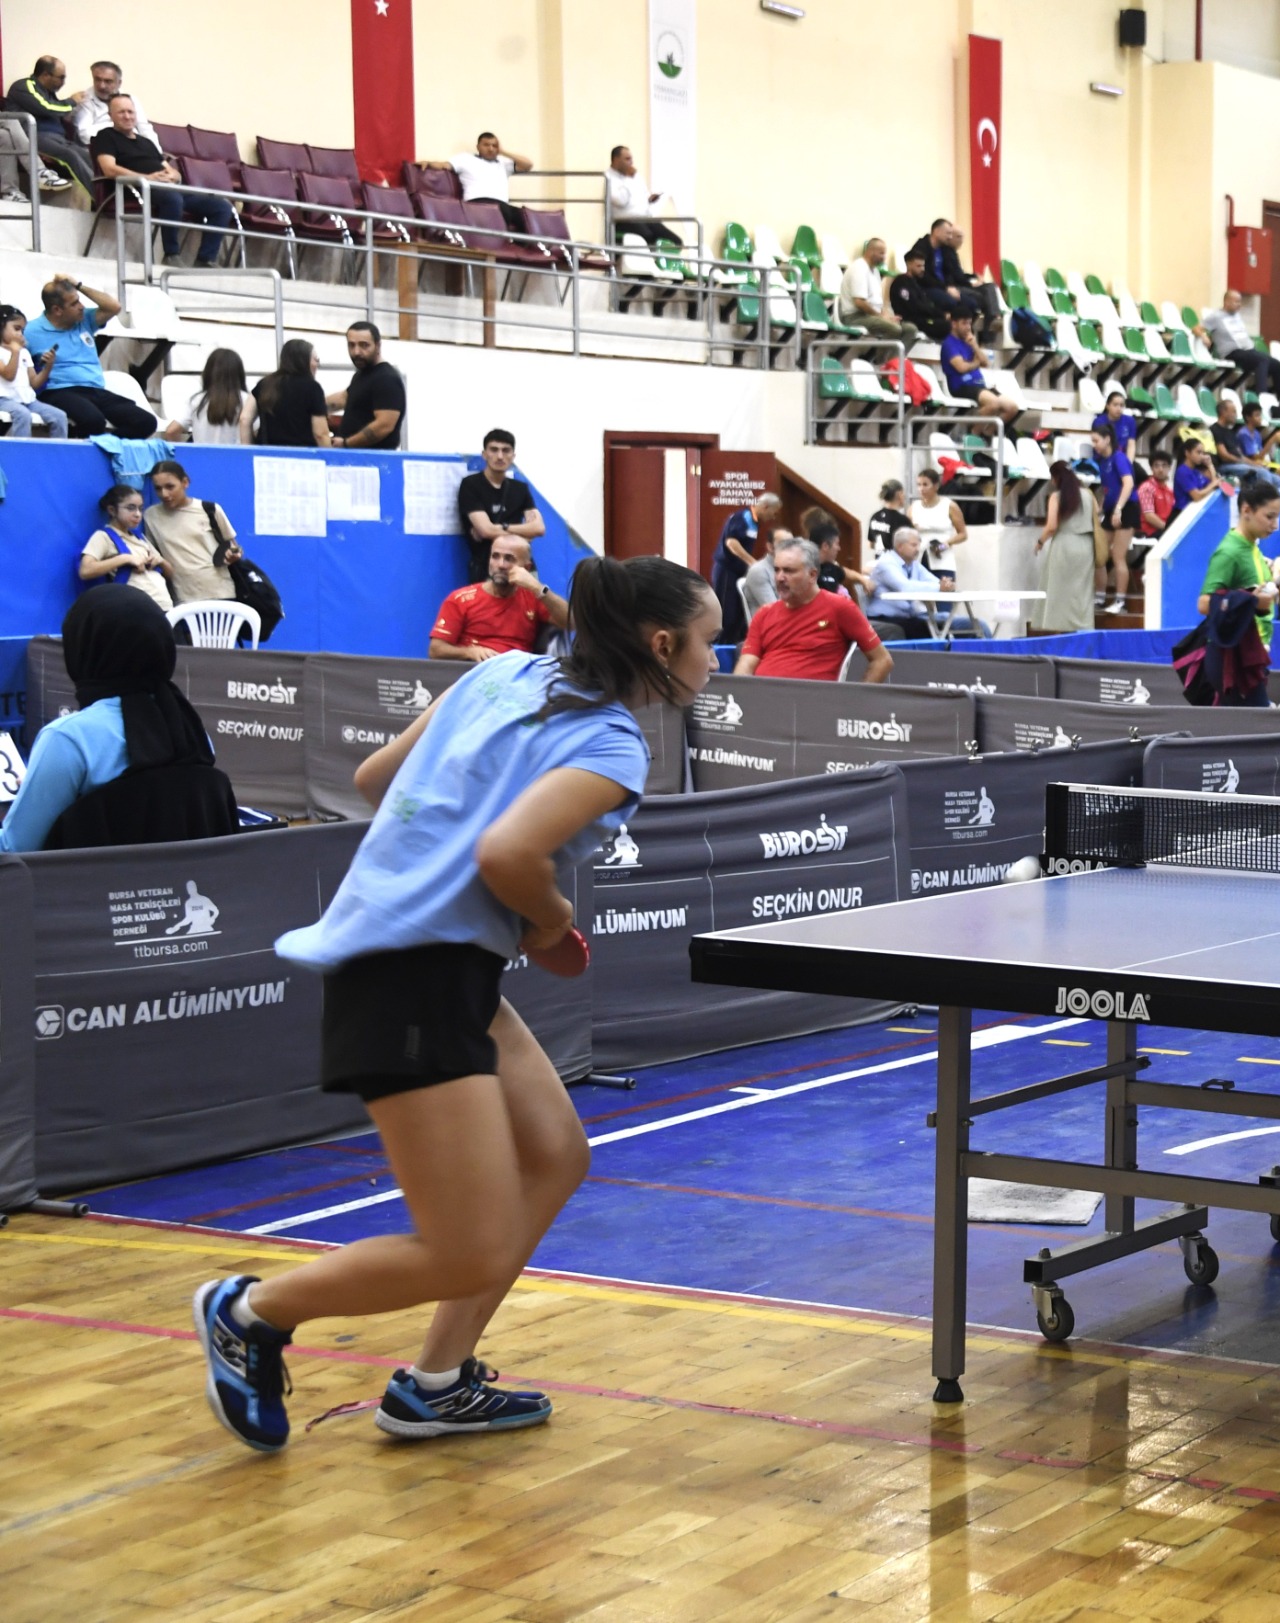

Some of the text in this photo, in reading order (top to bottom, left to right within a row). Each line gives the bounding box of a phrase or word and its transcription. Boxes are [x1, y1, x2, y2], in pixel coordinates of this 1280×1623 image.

[724, 472, 749, 481] SPOR
[719, 490, 754, 498] SAHAYA
[217, 719, 267, 738] SEÇKİN
[357, 732, 385, 745] CAN
[700, 748, 774, 772] ALÜMİNYUM
[1047, 857, 1105, 876] JOOLA
[922, 870, 949, 889] CAN
[108, 888, 174, 901] BURSA VETERAN
[752, 886, 863, 921] SEÇKİN ONUR
[109, 903, 133, 913] MASA
[134, 896, 182, 911] TENİSÇİLERİ
[111, 911, 166, 925] SPOR KULÜBÜ
[113, 923, 148, 937] DERNEĞİ
[133, 940, 209, 959] ttbursa.com
[66, 980, 286, 1033] CAN ALÜMİNYUM
[1055, 986, 1151, 1021] JOOLA
